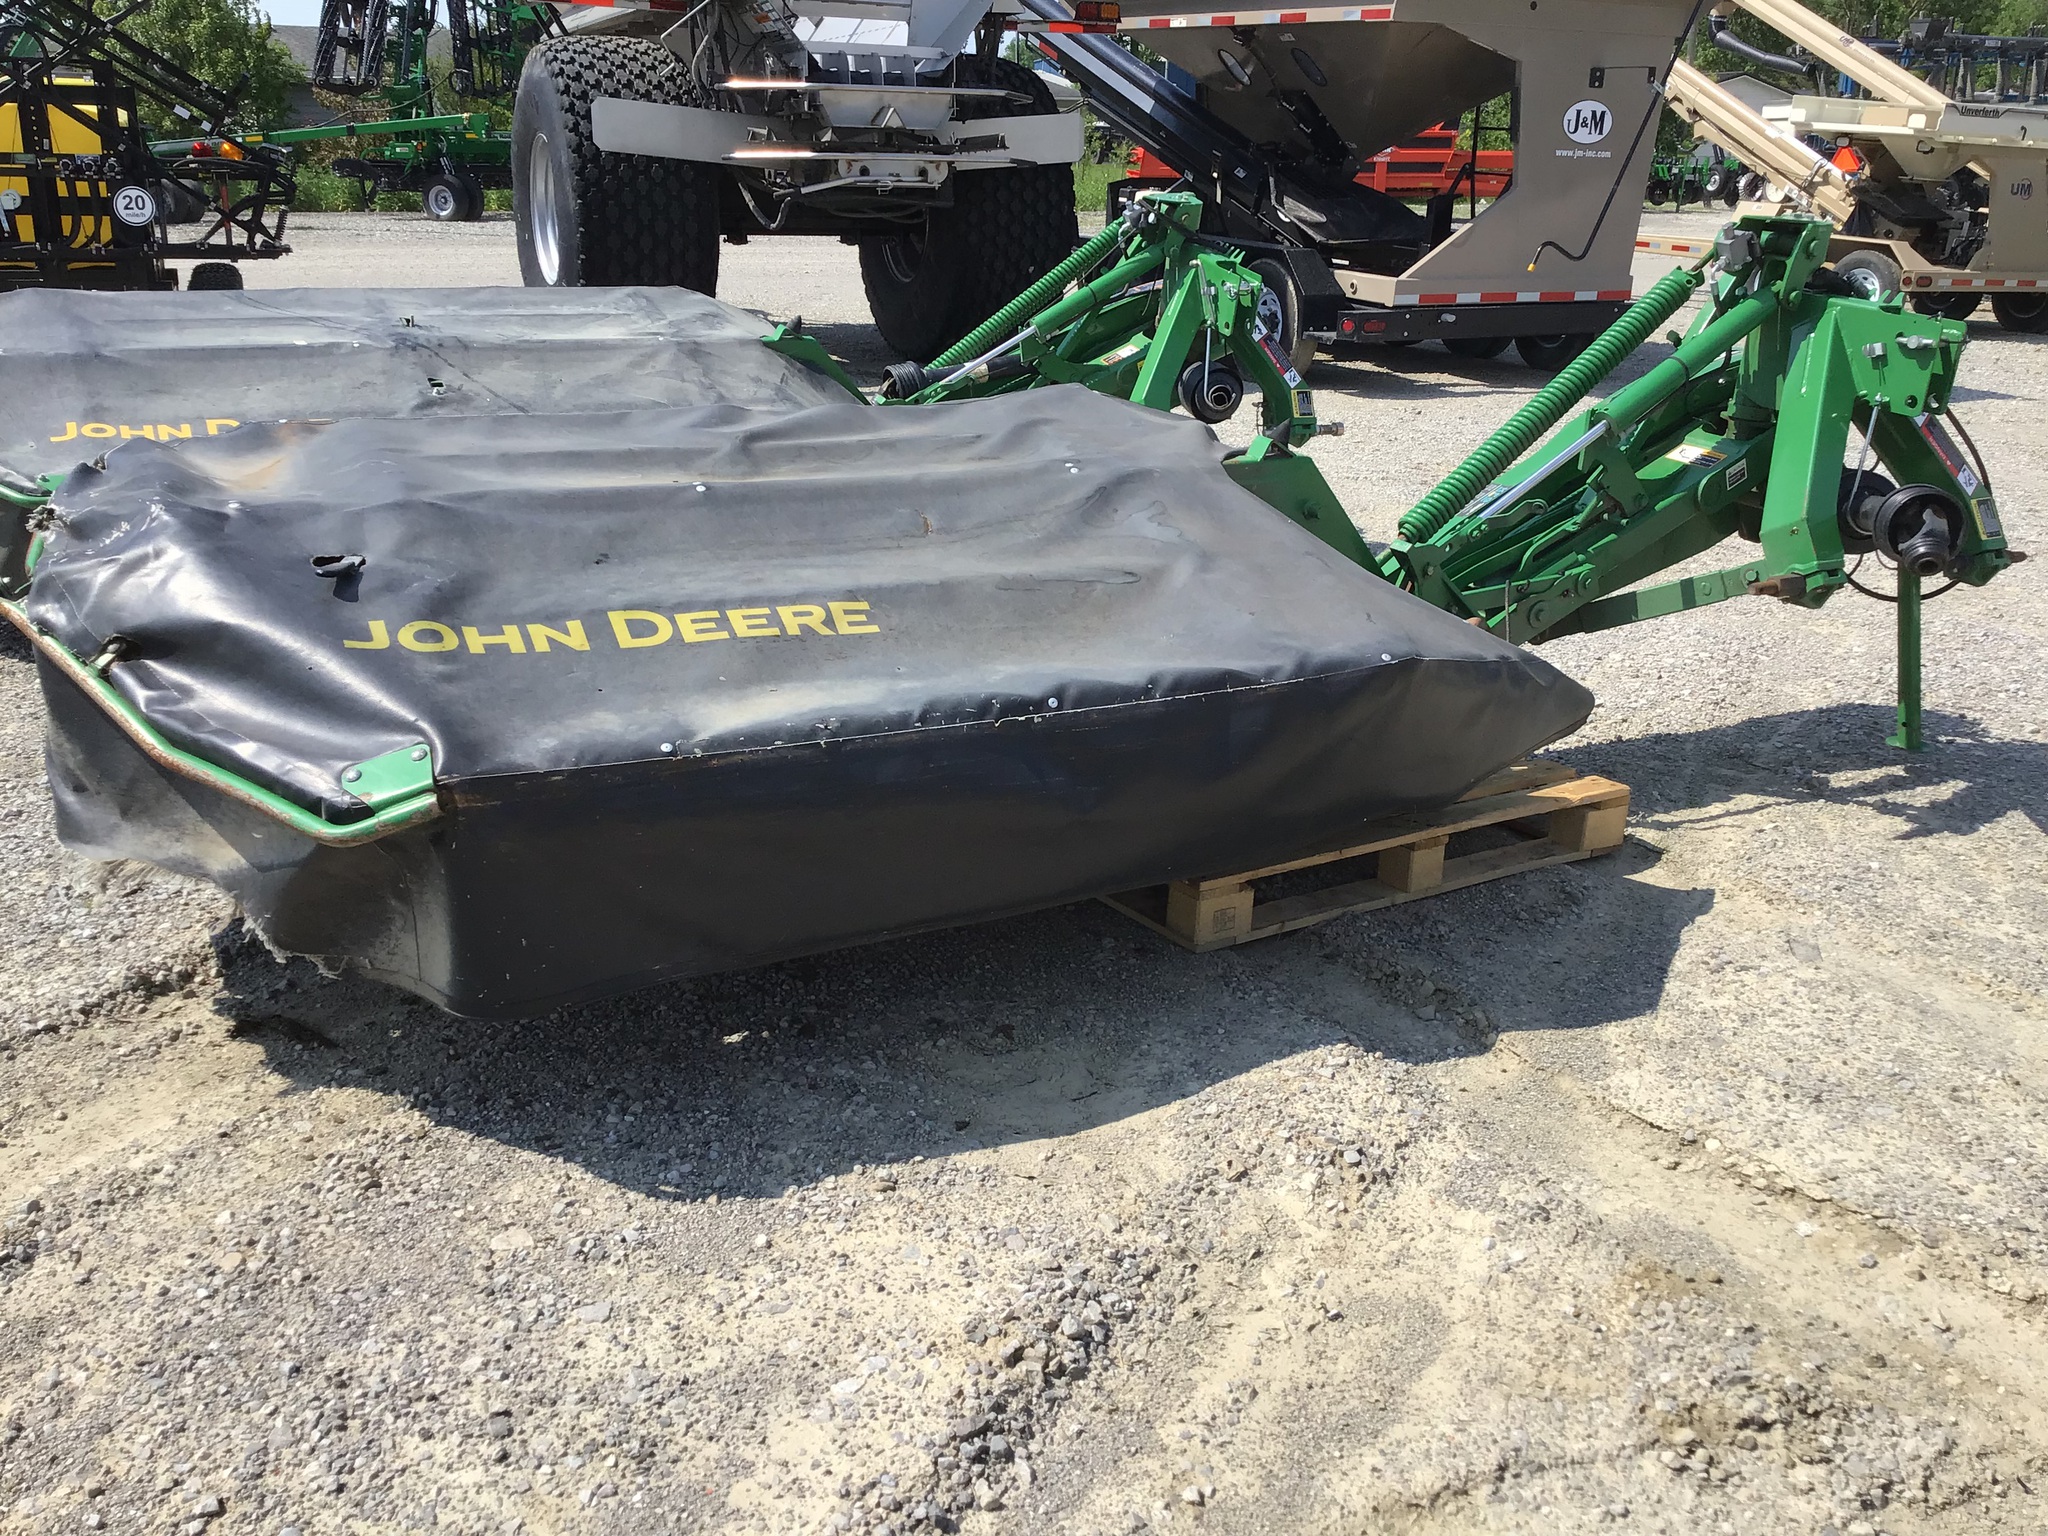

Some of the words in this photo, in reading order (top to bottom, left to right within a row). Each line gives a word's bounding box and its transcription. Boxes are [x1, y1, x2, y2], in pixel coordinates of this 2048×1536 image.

[1567, 109, 1607, 135] J&M
[1555, 148, 1612, 159] www.jm-inc.com
[122, 194, 146, 211] 20
[50, 421, 193, 442] JOHN
[343, 619, 591, 654] JOHN
[606, 600, 882, 649] DEERE
